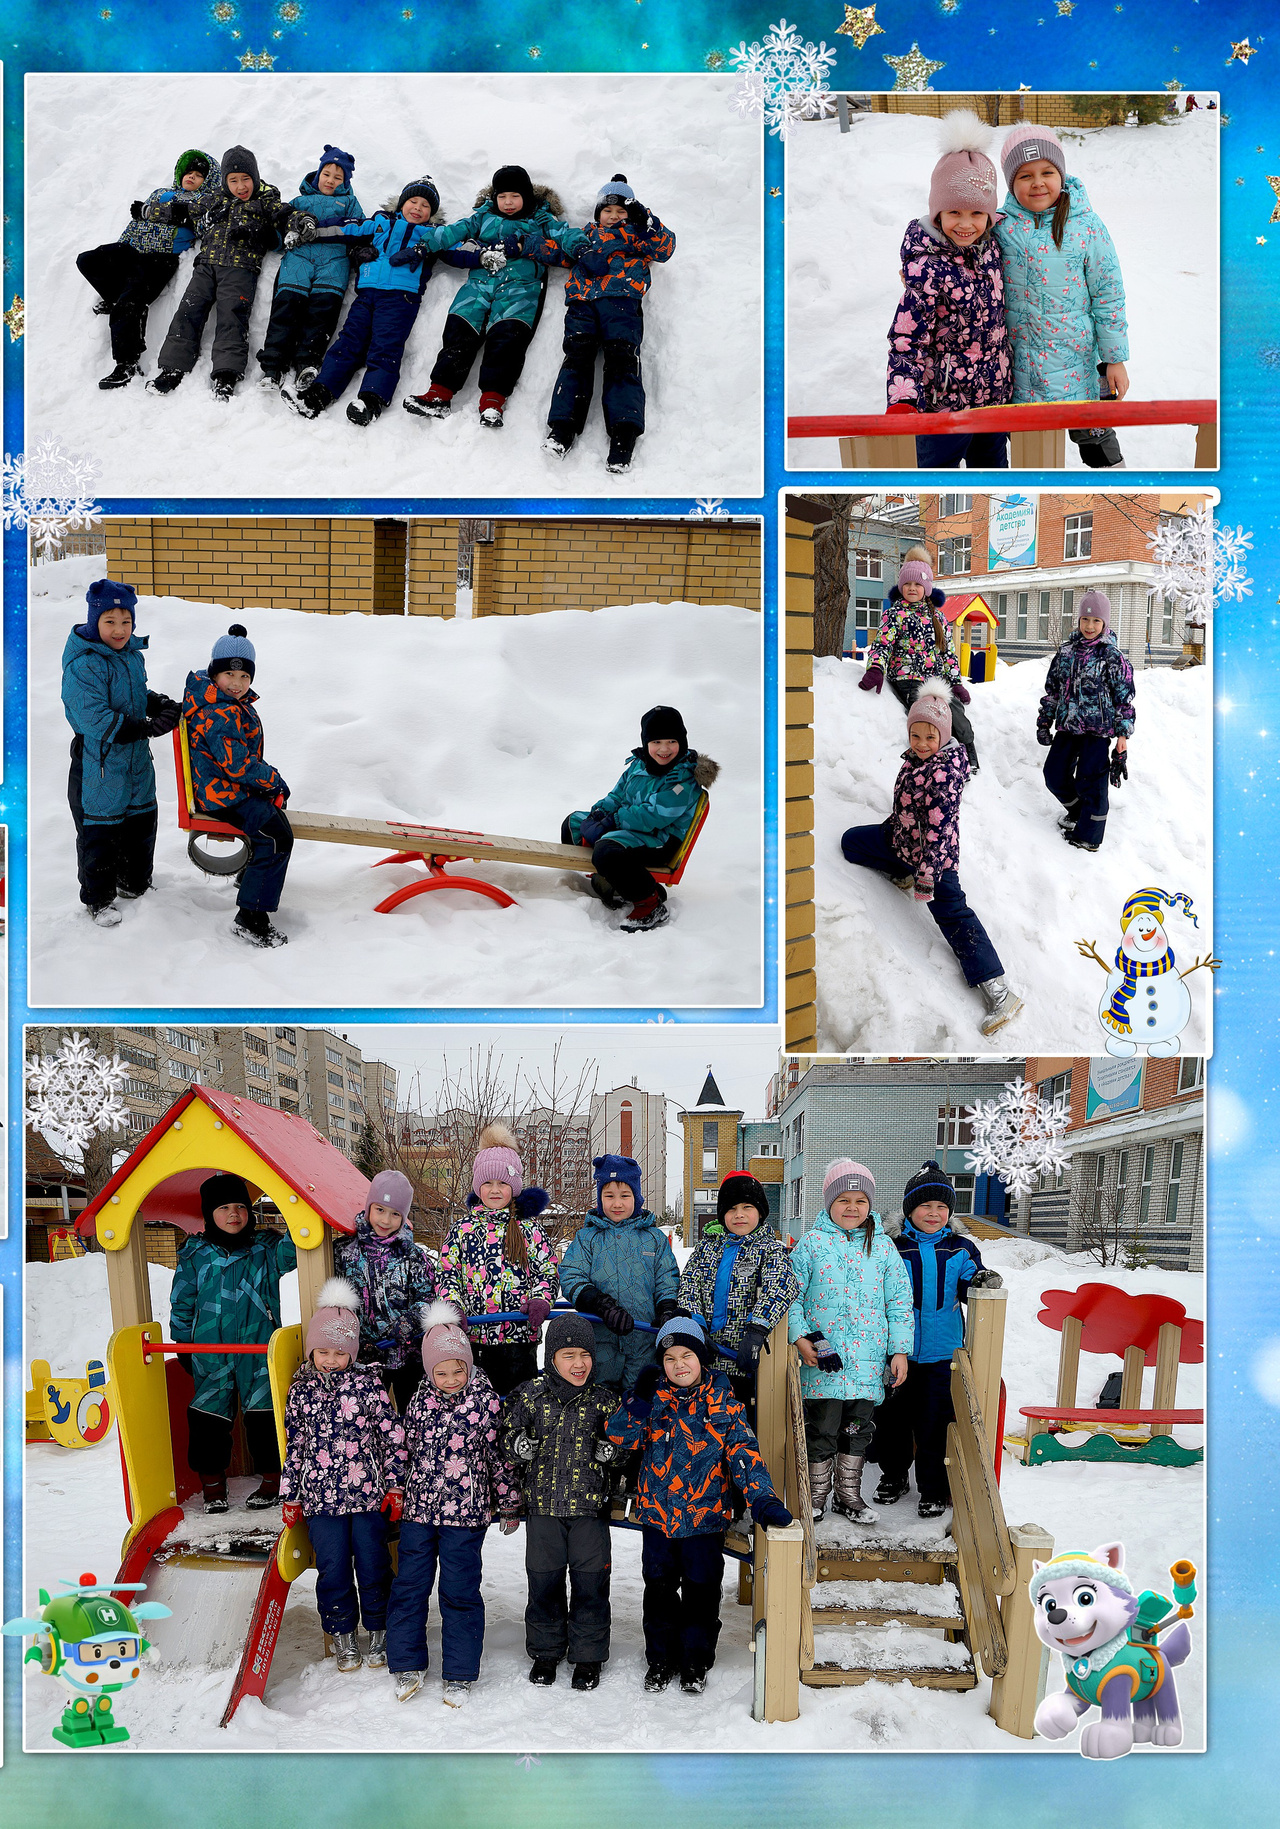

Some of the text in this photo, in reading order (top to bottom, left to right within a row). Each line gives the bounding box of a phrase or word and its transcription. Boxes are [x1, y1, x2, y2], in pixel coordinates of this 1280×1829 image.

[996, 508, 1031, 522] Академия
[999, 519, 1026, 532] детства
[100, 1608, 117, 1621] H
